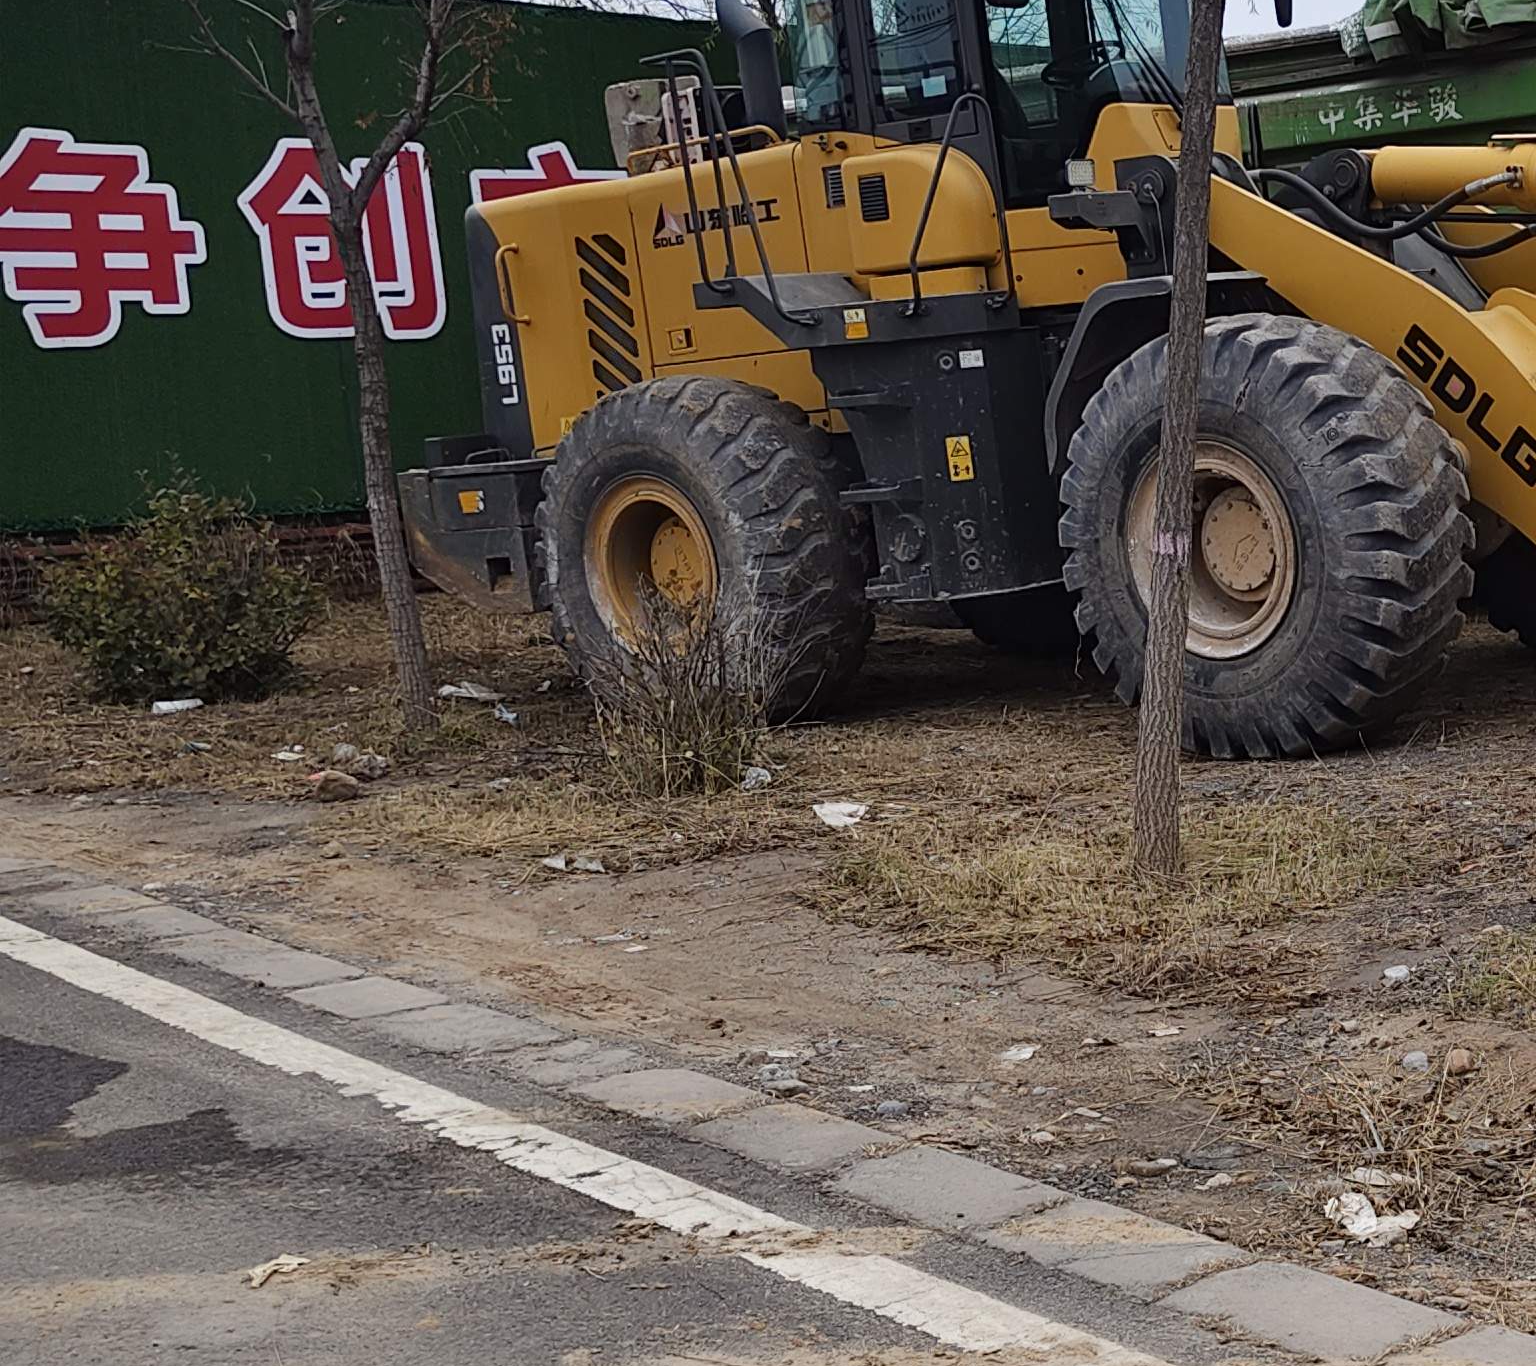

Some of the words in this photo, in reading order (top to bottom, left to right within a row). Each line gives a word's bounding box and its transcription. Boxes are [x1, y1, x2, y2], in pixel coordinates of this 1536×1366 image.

[0, 128, 630, 350] 争创
[653, 235, 685, 249] SDLG
[491, 323, 519, 405] L953
